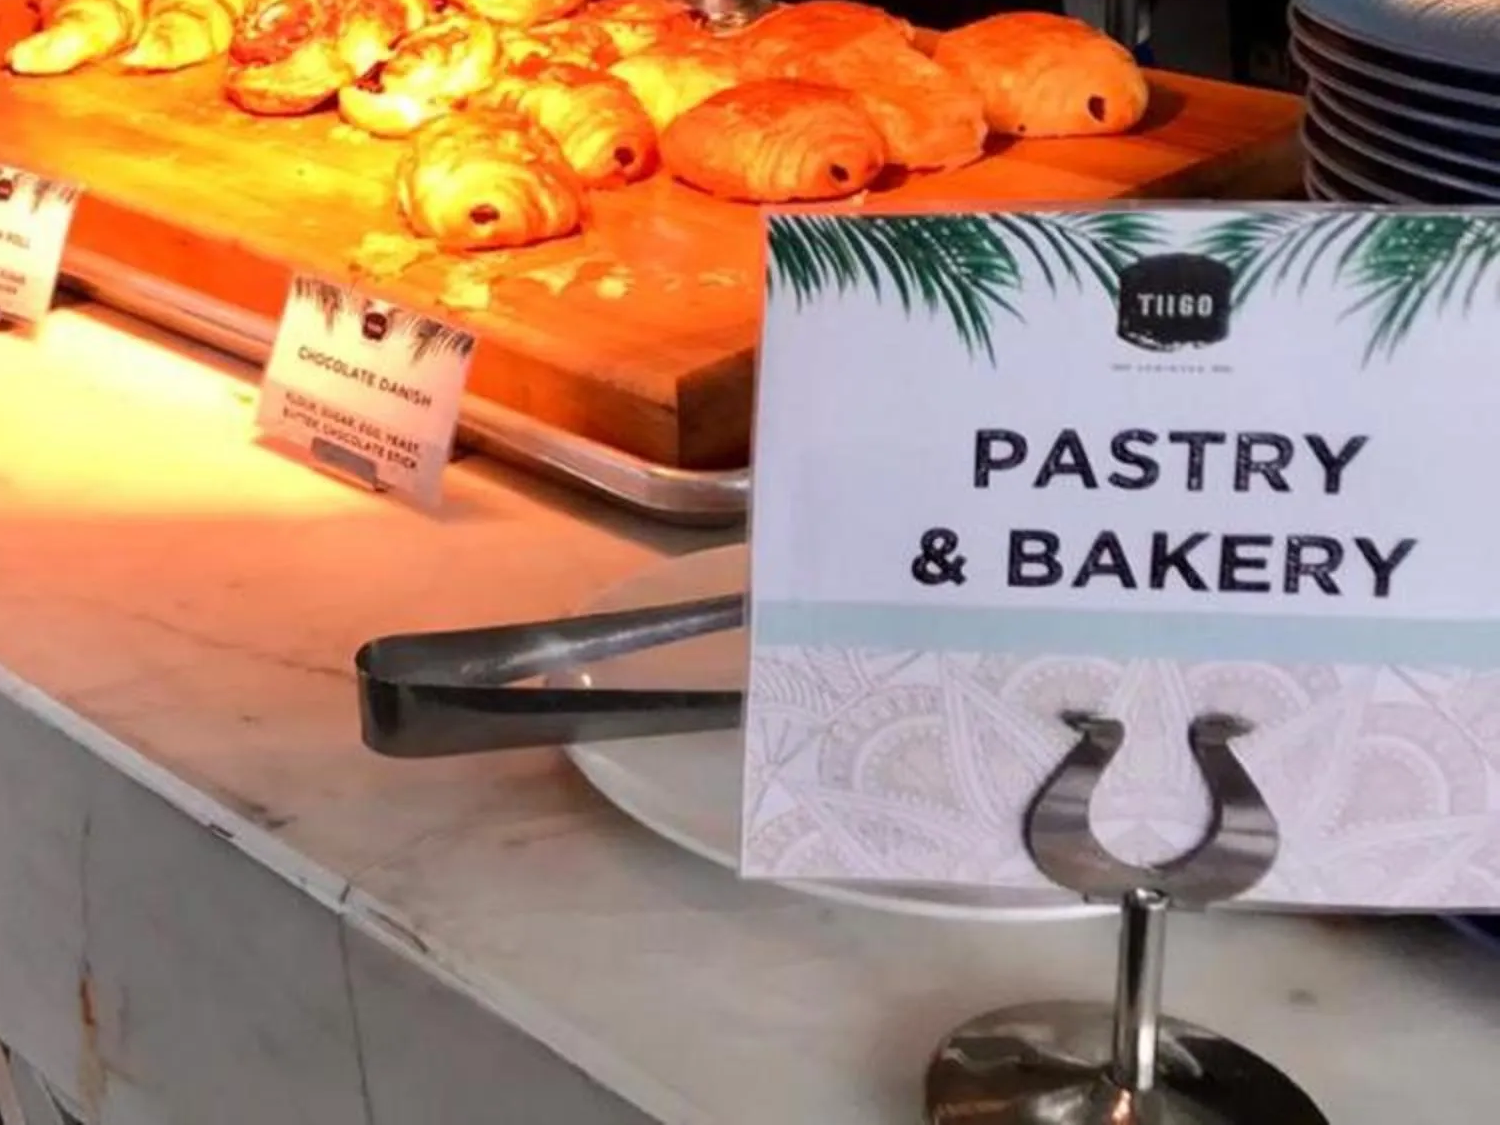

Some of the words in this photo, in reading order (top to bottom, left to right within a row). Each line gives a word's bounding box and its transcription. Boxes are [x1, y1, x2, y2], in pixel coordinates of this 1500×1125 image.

[1136, 292, 1214, 317] TIIGO
[298, 344, 376, 387] CHOCOLATE
[379, 377, 433, 408] DANISH
[971, 427, 1372, 496] PASTRY
[910, 526, 968, 587] &
[1005, 528, 1420, 599] BAKERY
